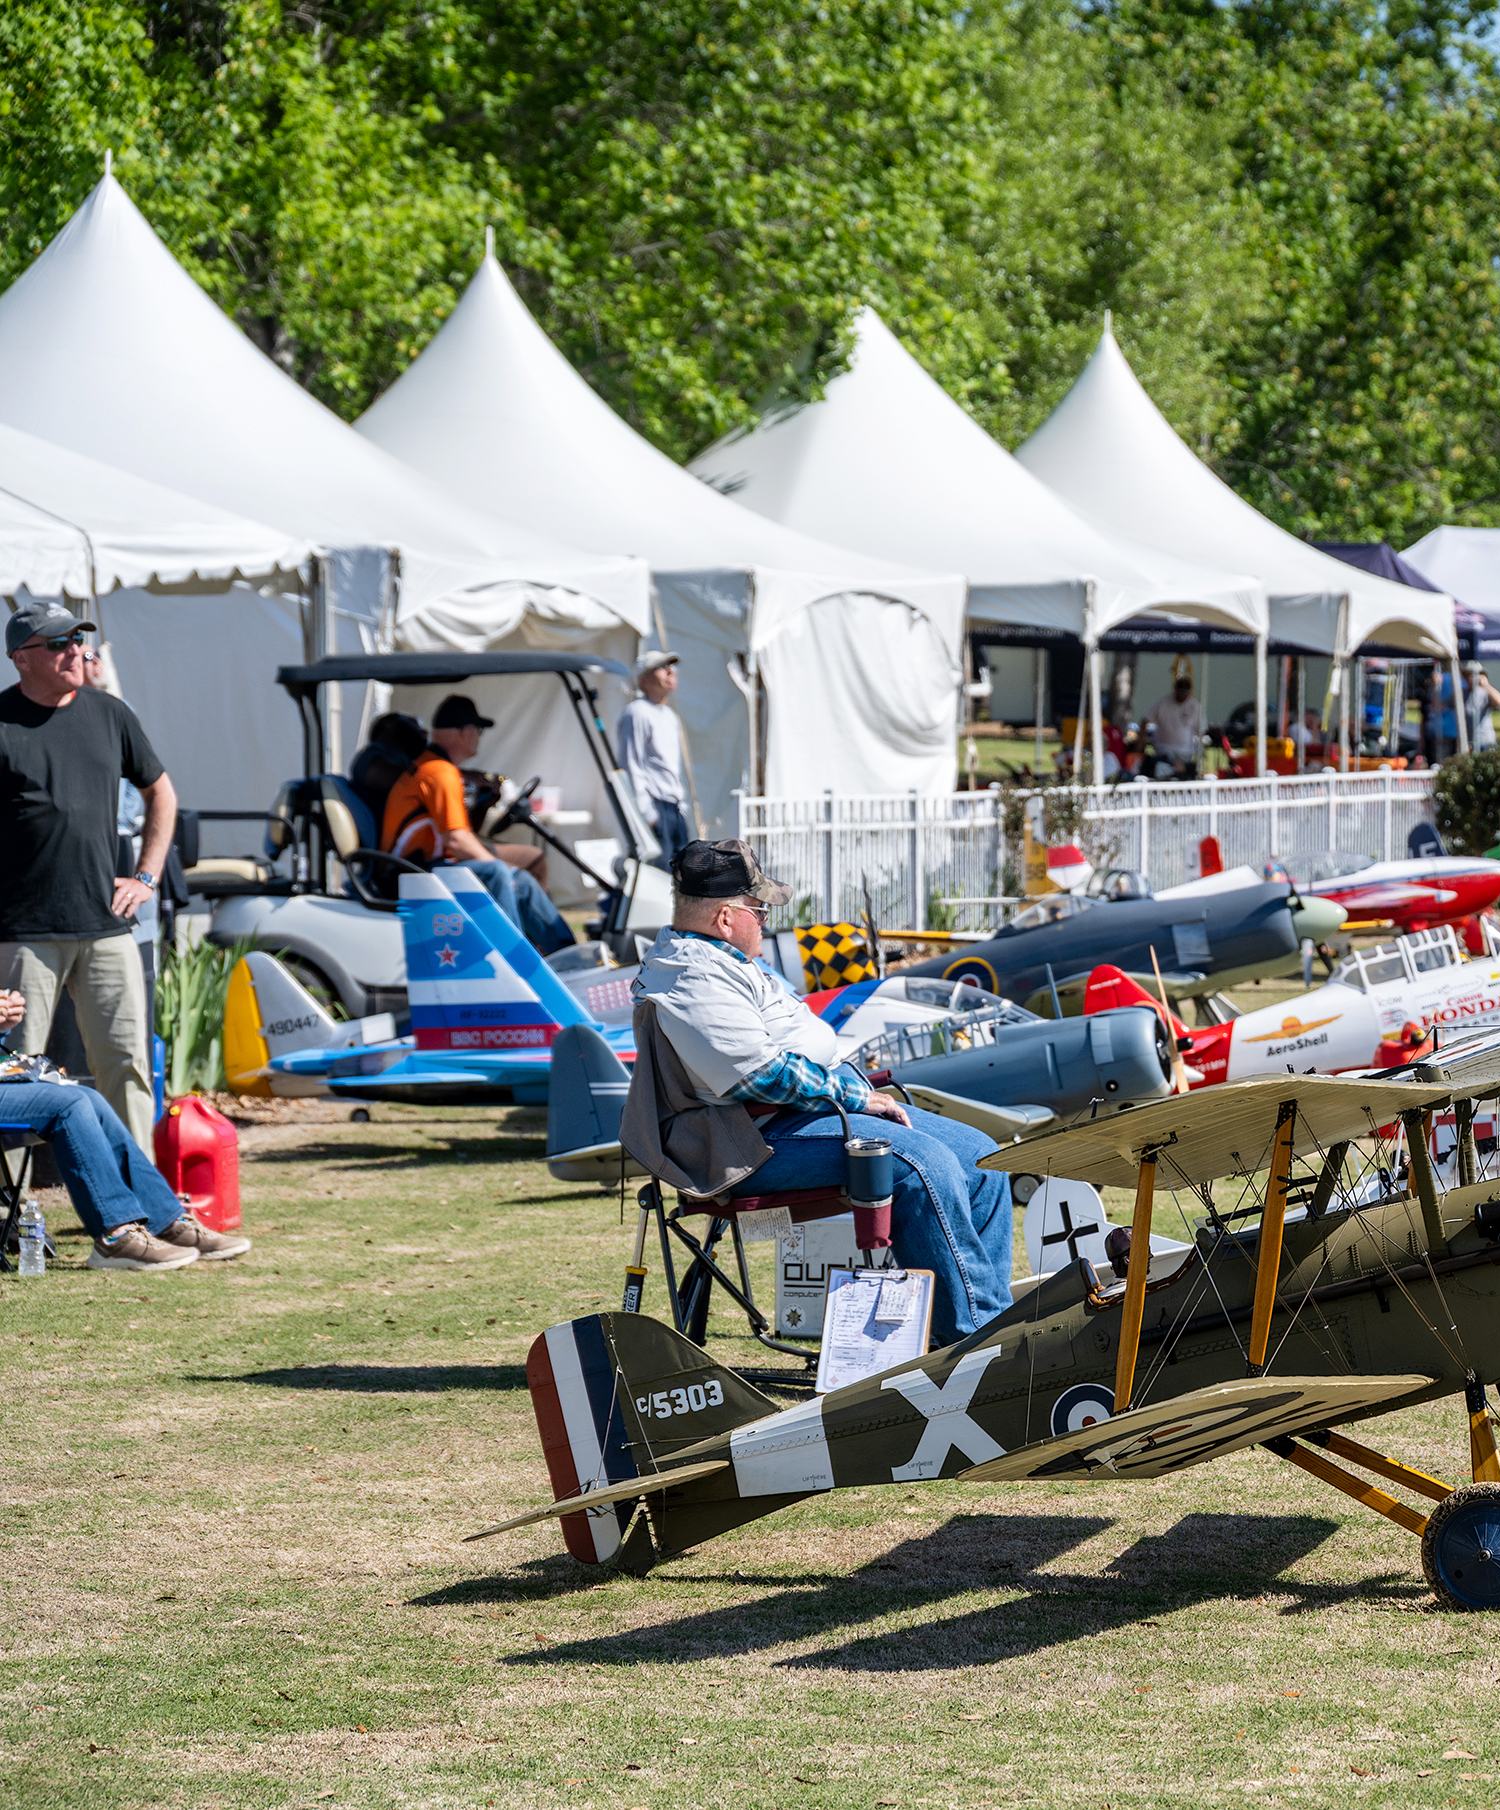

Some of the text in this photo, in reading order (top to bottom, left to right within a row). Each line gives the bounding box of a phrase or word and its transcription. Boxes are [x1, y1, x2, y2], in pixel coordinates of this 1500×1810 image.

[432, 912, 464, 937] 69
[266, 1013, 320, 1037] 490447
[450, 1030, 481, 1047] ВВС
[1265, 1032, 1329, 1058] AeroShell
[783, 1291, 824, 1299] computer
[880, 1343, 1008, 1482] X
